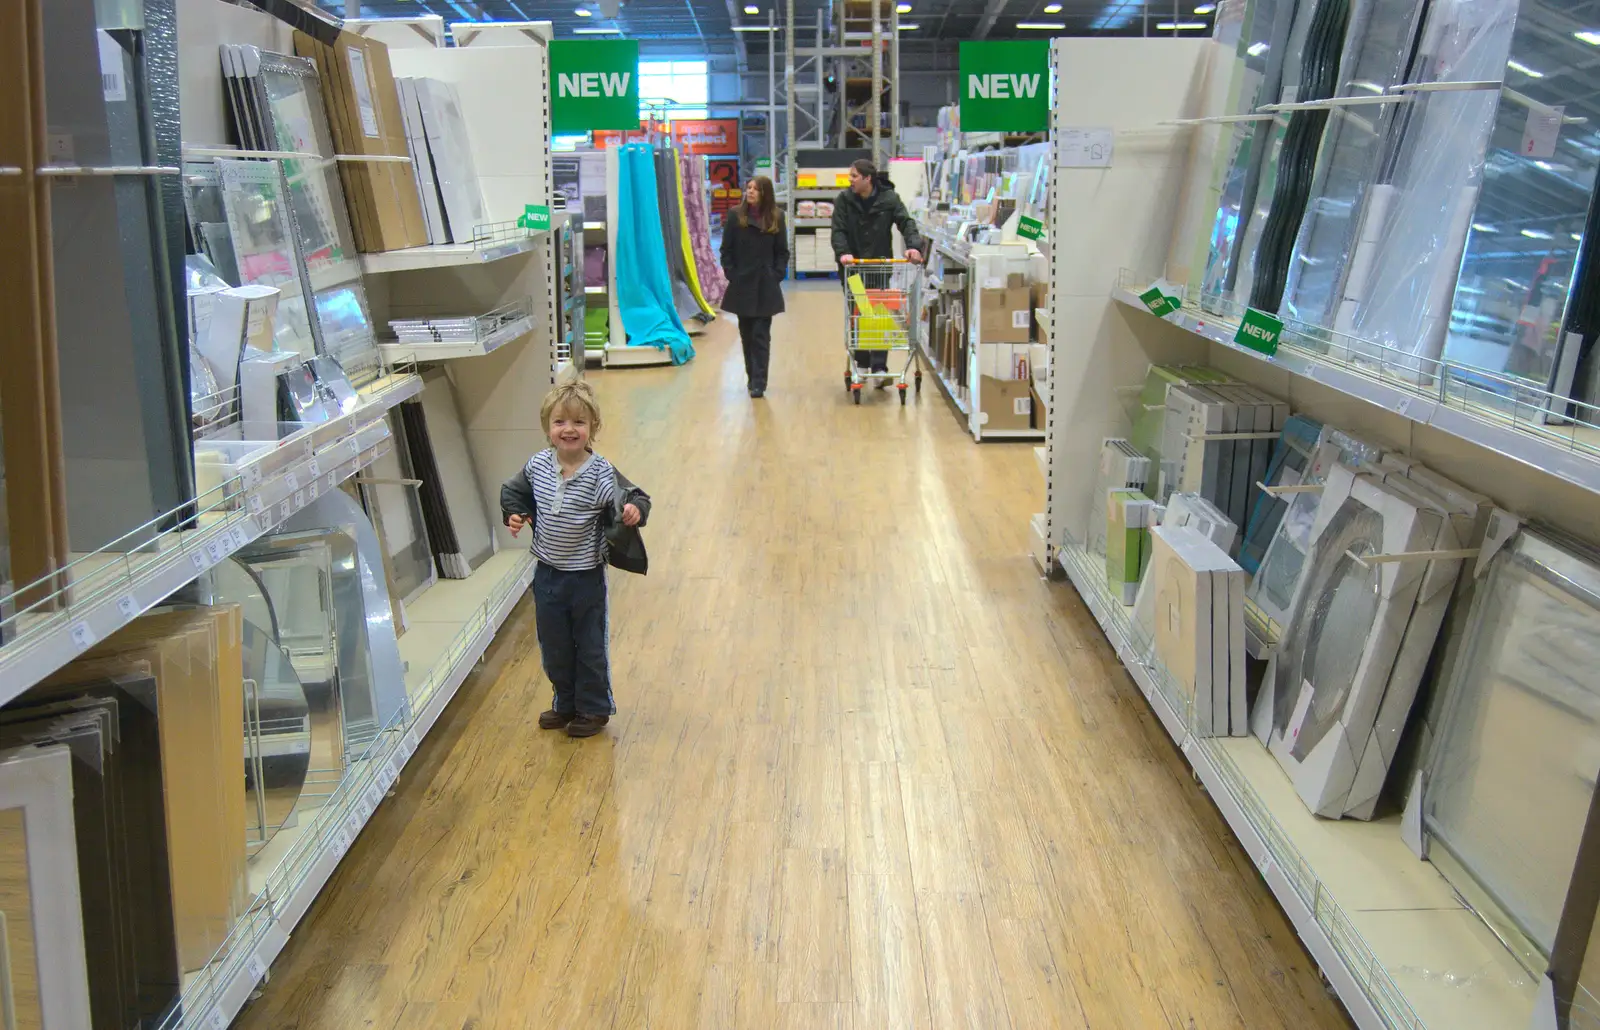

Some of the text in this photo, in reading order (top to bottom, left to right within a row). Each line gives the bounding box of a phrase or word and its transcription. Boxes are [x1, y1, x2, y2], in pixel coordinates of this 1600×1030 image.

[558, 72, 630, 97] NEW
[968, 73, 1040, 99] NEW
[527, 212, 549, 222] NEW
[1020, 222, 1040, 235] NEW
[1147, 296, 1166, 310] NEW
[1242, 322, 1276, 342] NEW
